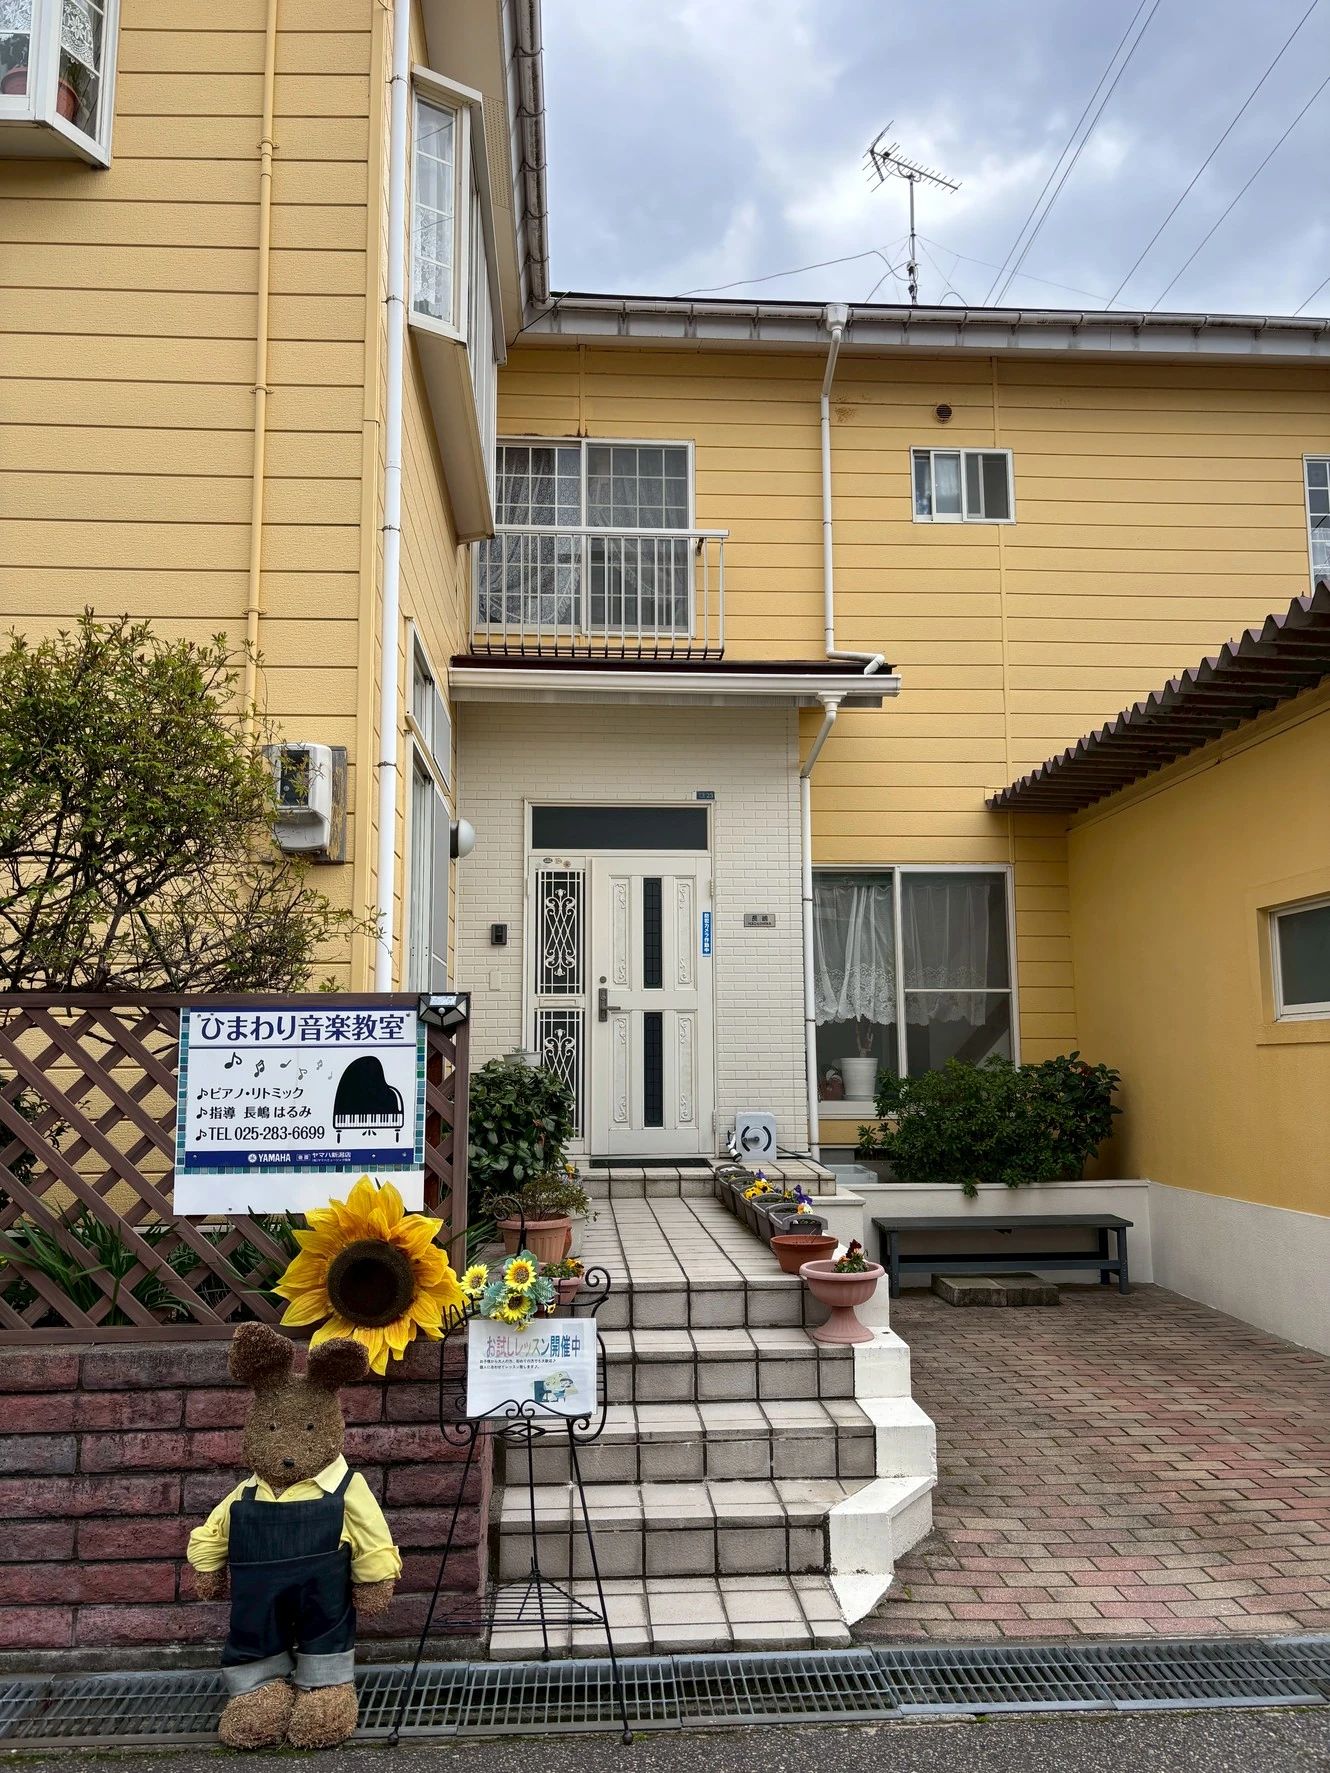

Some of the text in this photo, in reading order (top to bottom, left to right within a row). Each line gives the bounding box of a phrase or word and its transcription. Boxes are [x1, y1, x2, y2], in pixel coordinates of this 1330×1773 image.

[200, 1013, 405, 1042] ひまわり音楽教室
[210, 1086, 304, 1100] ピアノ・リトミック
[209, 1105, 312, 1120] 指導 長嶋 はるみ
[208, 1125, 325, 1141] TEL 025-283-6699
[258, 1153, 292, 1163] YAMAHA
[486, 1335, 581, 1358] お試しレッスン開催中
